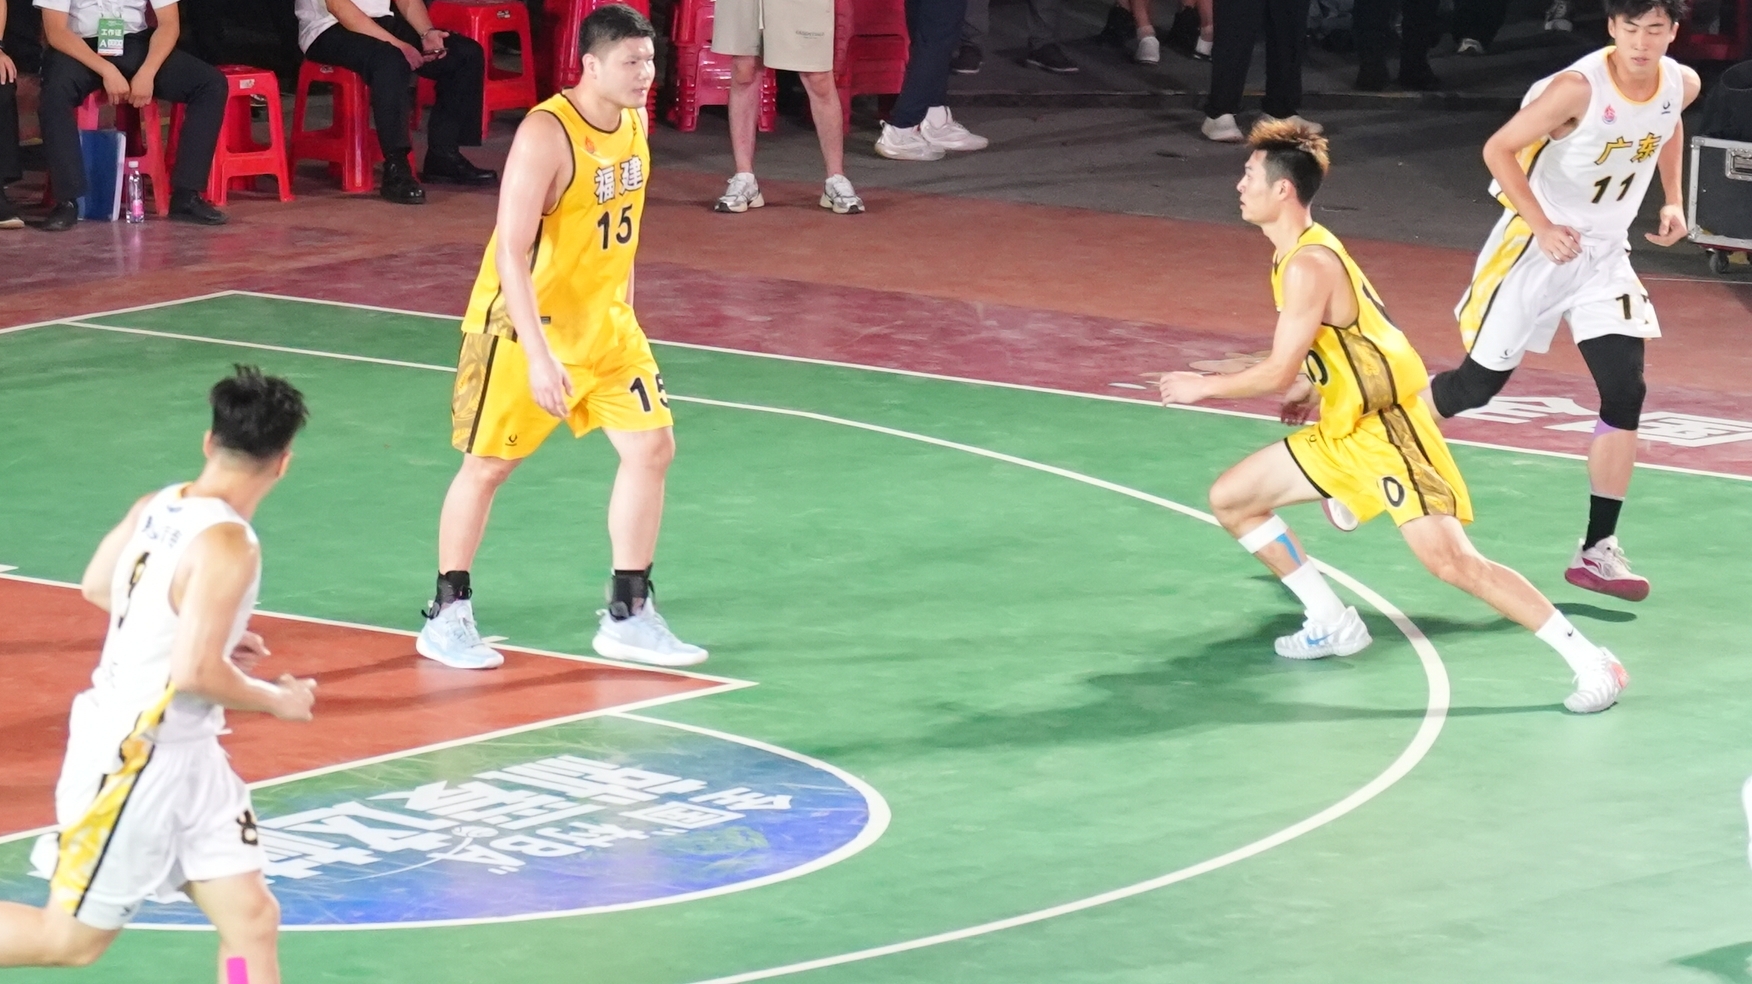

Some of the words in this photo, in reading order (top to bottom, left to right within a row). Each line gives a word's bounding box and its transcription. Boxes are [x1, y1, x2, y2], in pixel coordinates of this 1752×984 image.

[99, 39, 107, 48] A
[100, 28, 122, 36] 工作证
[1593, 131, 1663, 166] 广东
[593, 154, 644, 206] 福建
[1591, 172, 1636, 204] 11
[597, 203, 634, 251] 15
